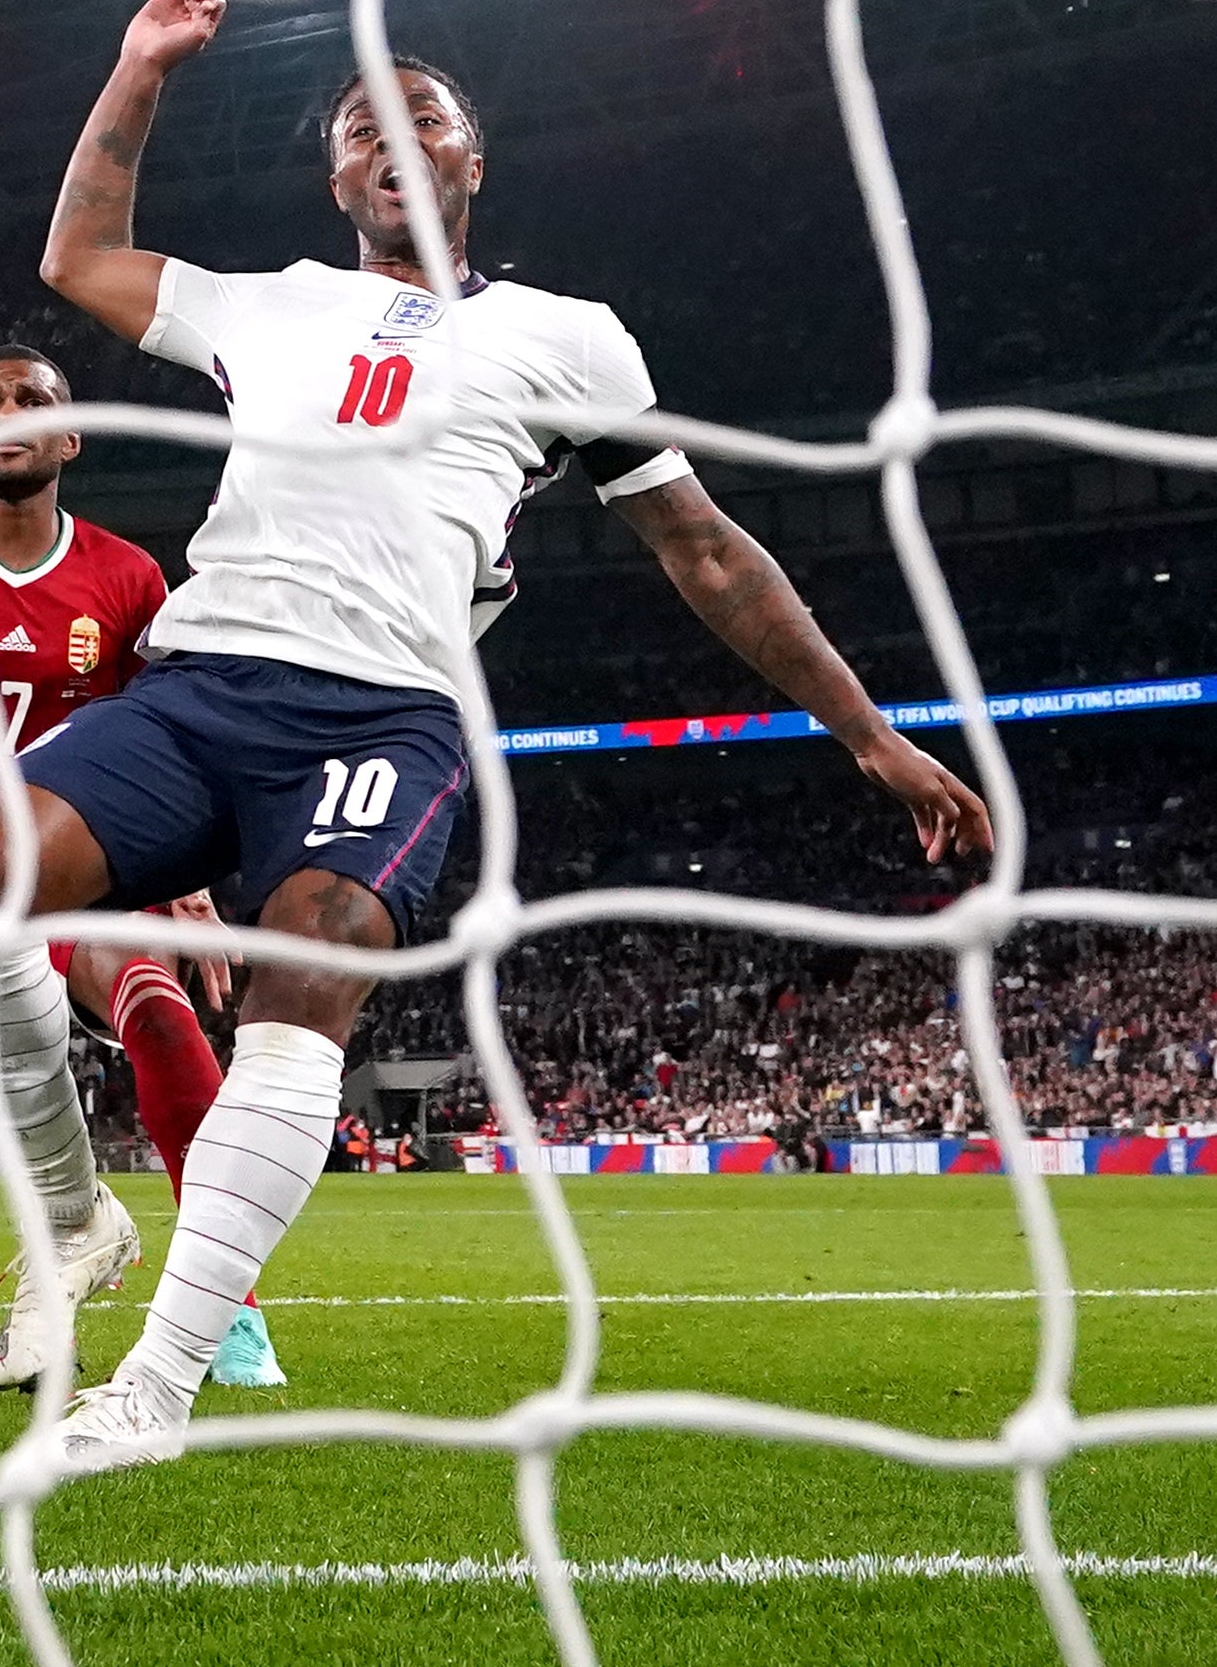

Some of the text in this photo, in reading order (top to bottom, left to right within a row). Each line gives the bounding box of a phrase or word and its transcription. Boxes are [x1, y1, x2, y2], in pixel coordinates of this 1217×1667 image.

[337, 353, 414, 427] 10
[1, 681, 33, 754] 7
[896, 706, 931, 724] FIFA
[989, 698, 1020, 717] CUP
[1021, 690, 1113, 717] QUALIFYING
[1114, 681, 1202, 706] CONTINUES
[511, 729, 600, 750] CONTINUES
[312, 757, 399, 827] 10
